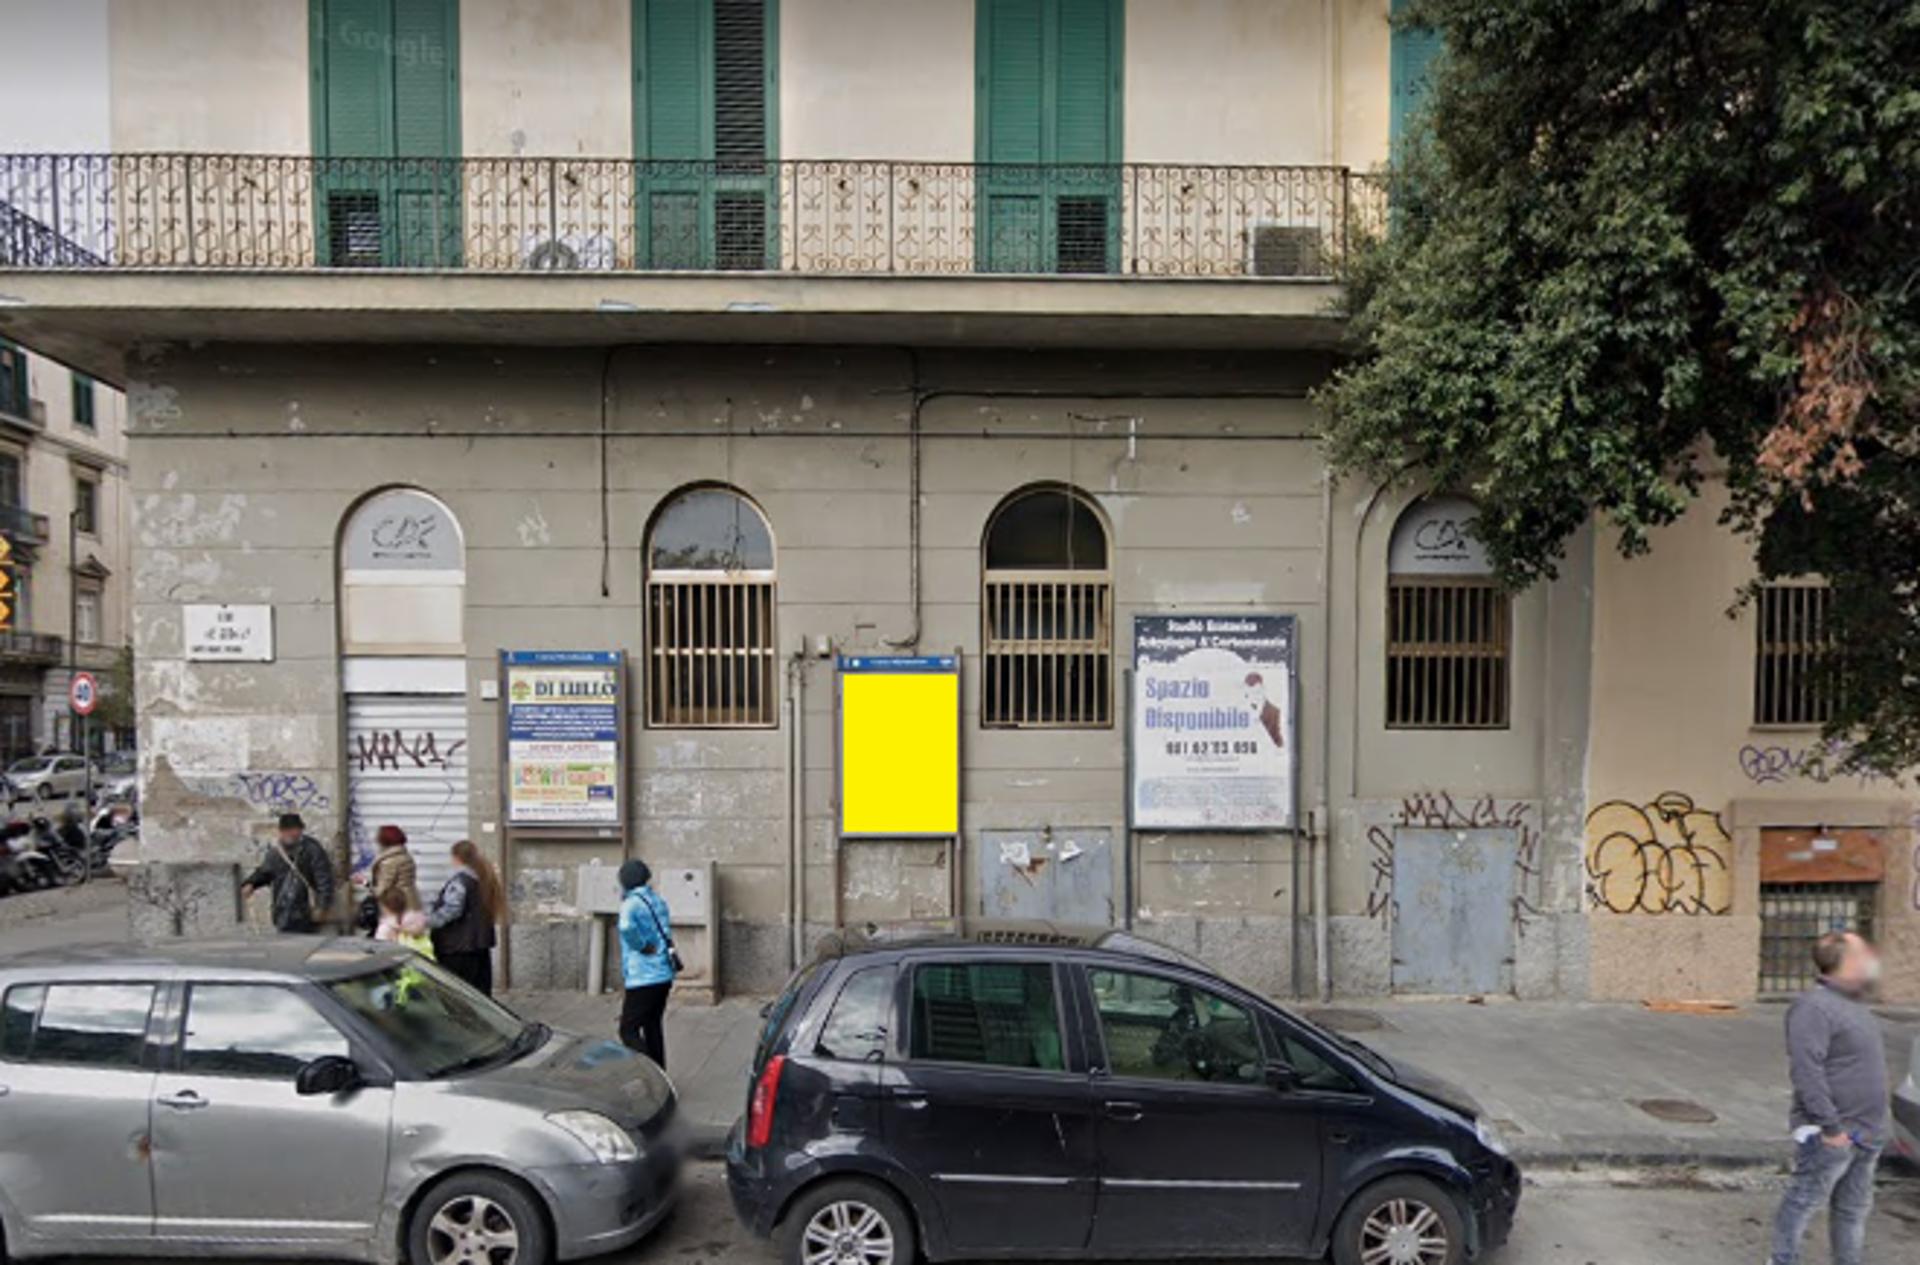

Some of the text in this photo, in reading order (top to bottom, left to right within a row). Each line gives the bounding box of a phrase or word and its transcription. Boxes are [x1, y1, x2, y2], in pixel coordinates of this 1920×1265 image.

[535, 681, 554, 696] DI
[1145, 677, 1211, 701] Spazio
[1145, 706, 1250, 733] Disponibile
